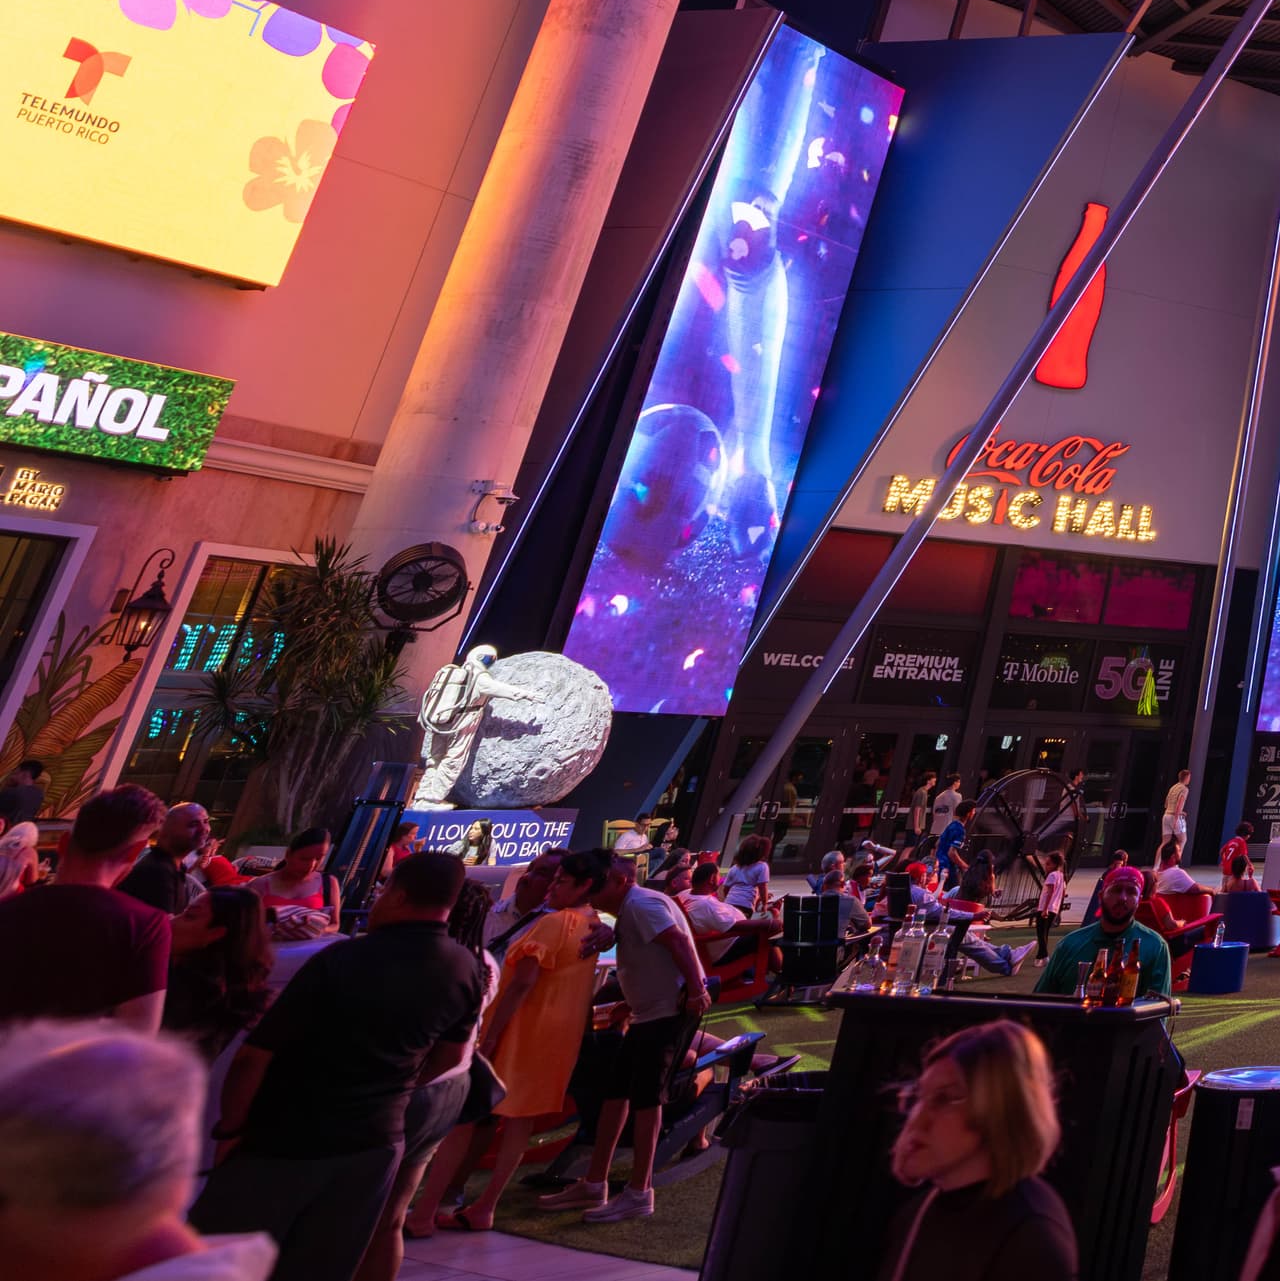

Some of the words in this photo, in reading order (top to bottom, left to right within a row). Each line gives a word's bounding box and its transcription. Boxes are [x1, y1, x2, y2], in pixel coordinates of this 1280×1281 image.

[20, 91, 120, 134] TELEMUNDO
[16, 108, 74, 139] PUERTO
[75, 124, 110, 146] RICO
[19, 469, 40, 481] BY
[13, 481, 66, 497] MARIO
[1052, 494, 1157, 542] HALL
[763, 652, 855, 671] WELCOE!
[884, 653, 959, 670] PREMIUM
[872, 667, 963, 682] ENTRANCE
[1021, 662, 1079, 685] Mobile
[1095, 656, 1155, 701] 5G
[1156, 658, 1176, 701] LINE
[428, 824, 436, 841] I
[437, 823, 470, 841] LOV
[491, 823, 516, 839] OU
[519, 822, 542, 839] TO
[543, 821, 571, 837] THE
[494, 842, 517, 858] ND
[1227, 847, 1236, 860] 7
